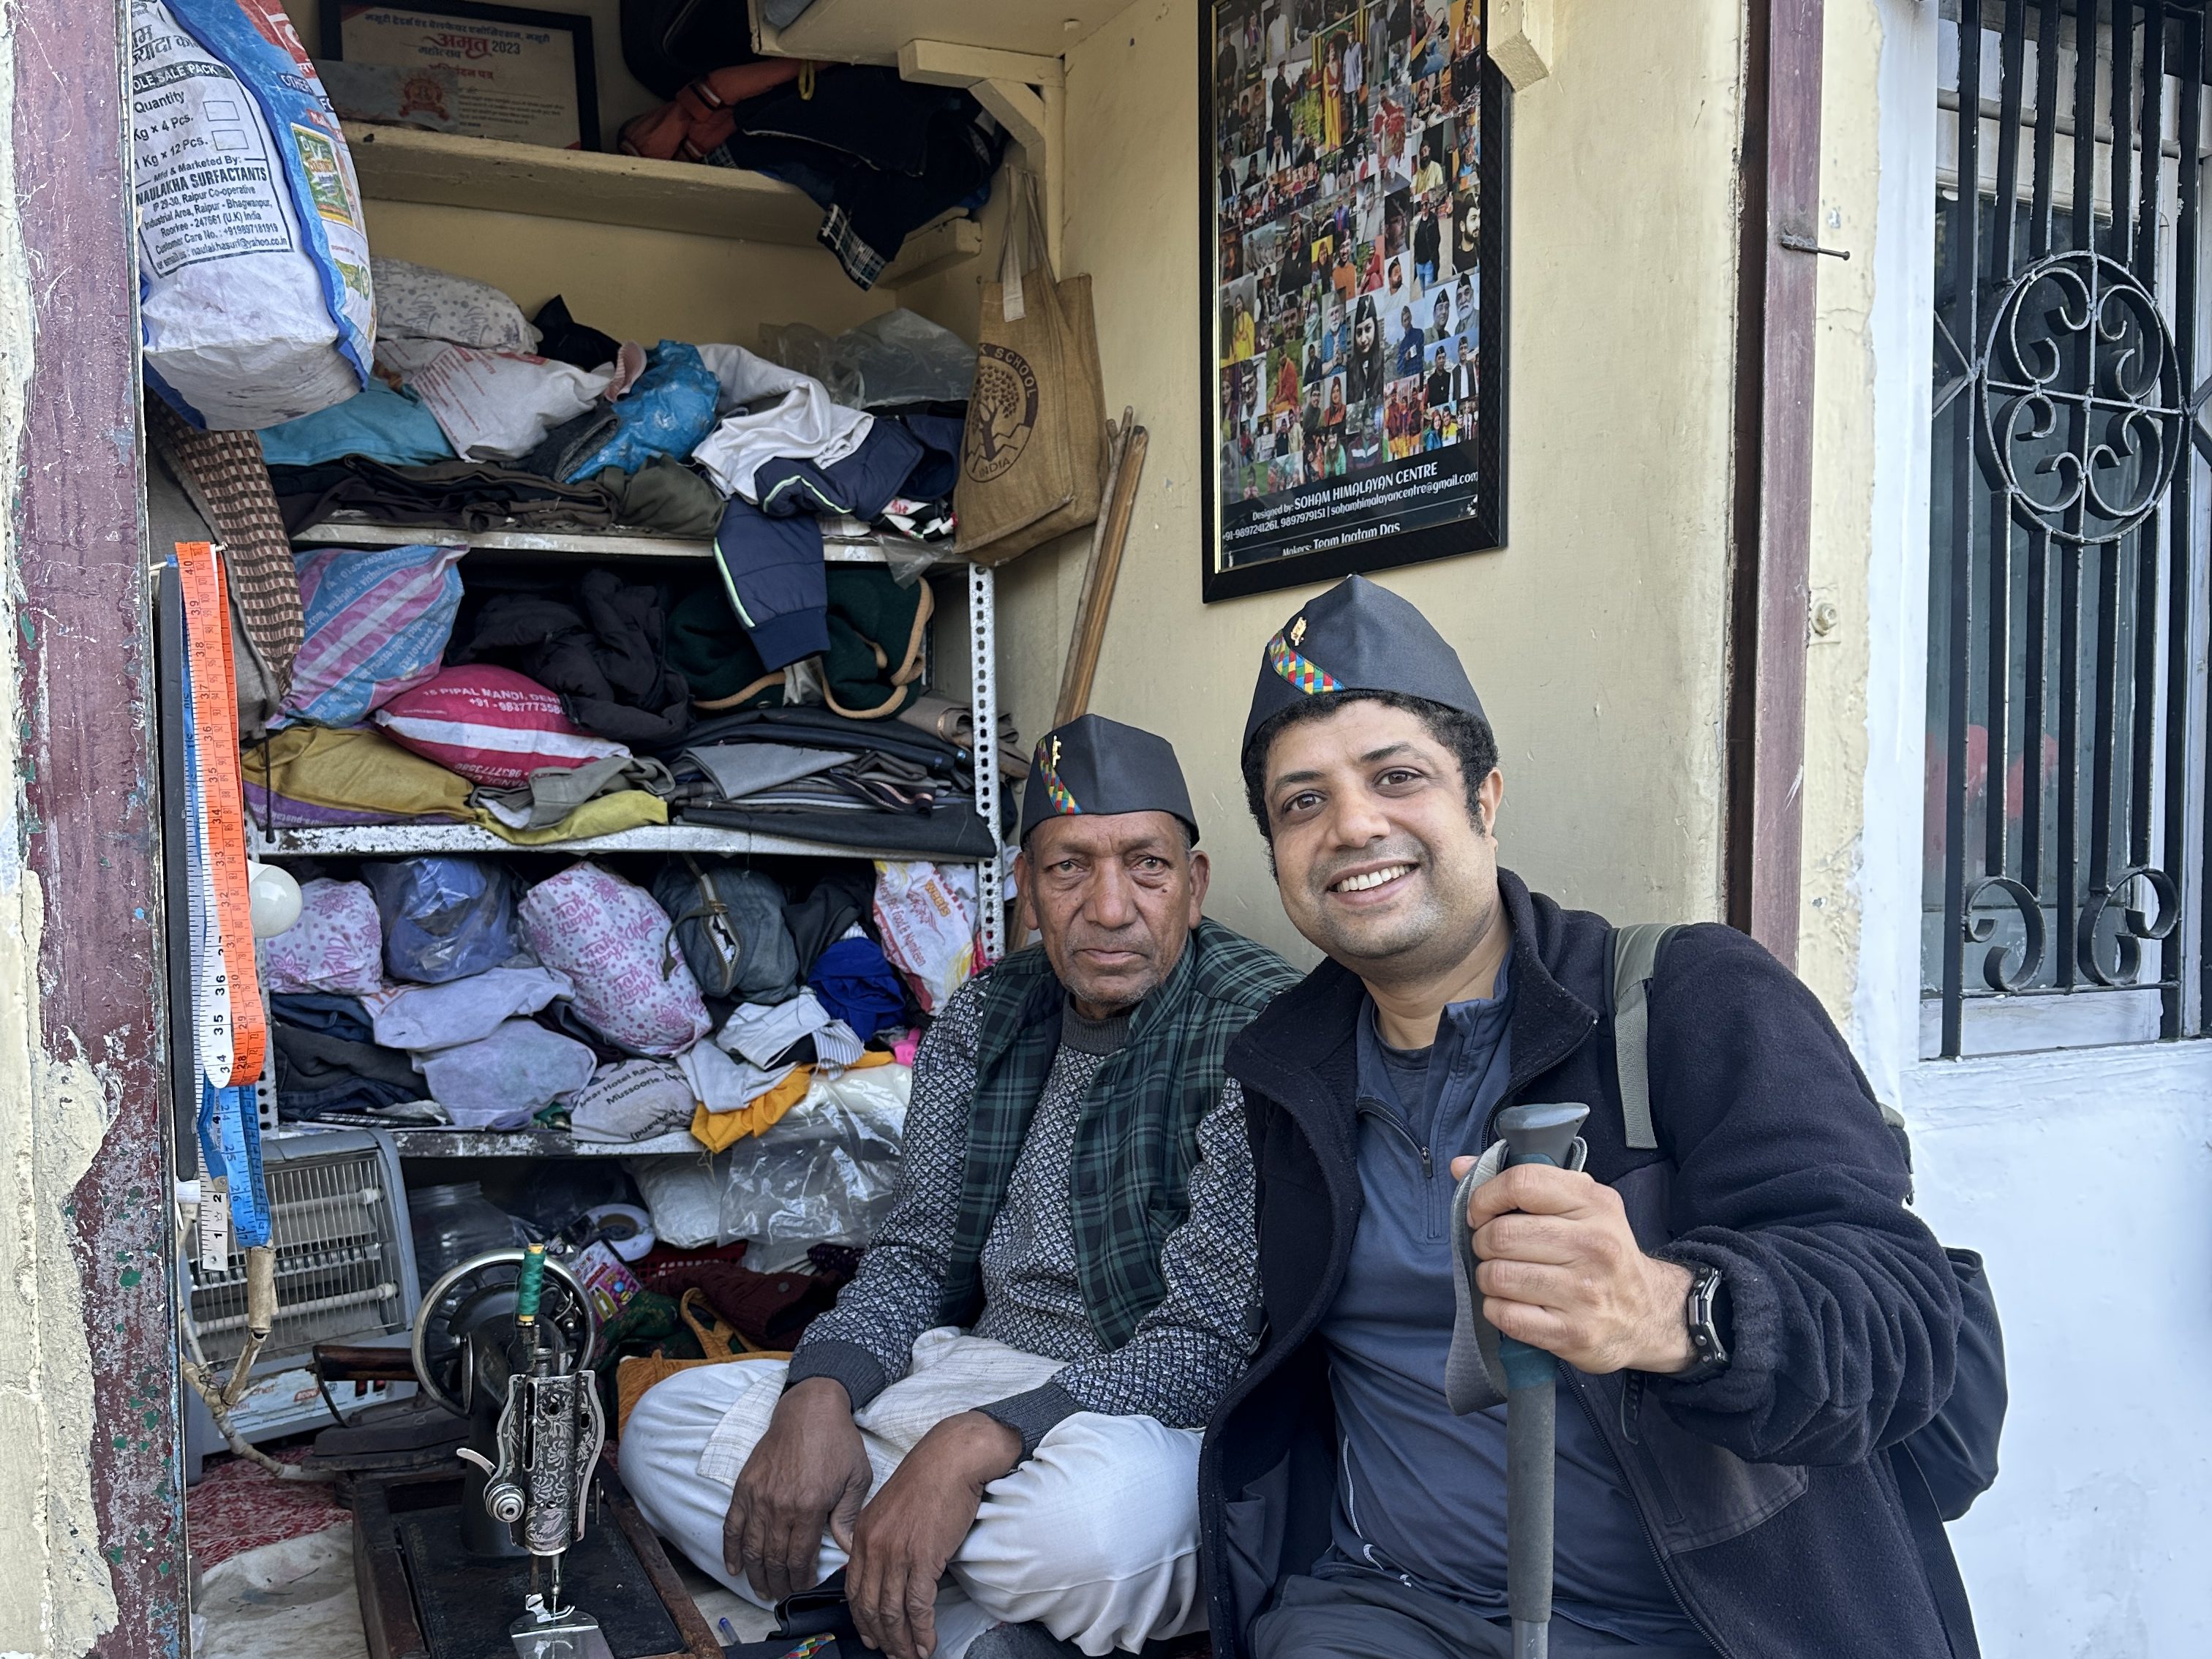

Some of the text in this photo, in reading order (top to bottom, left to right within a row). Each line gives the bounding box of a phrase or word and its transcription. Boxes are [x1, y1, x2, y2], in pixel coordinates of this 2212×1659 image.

[492, 40, 521, 55] 2023
[133, 63, 218, 91] OLE SALE PACK
[134, 91, 184, 113] Quantity
[162, 120, 169, 131] 4
[170, 114, 194, 129] Pcs.
[142, 154, 159, 167] Kg
[170, 143, 181, 156] 12
[183, 137, 208, 150] Pcs.
[178, 157, 222, 173] Marketed
[225, 156, 242, 166] By:
[135, 167, 268, 206] NAULAKHA SURFACTANTS
[183, 190, 208, 205] Raipur
[208, 185, 256, 198] Co-operative
[174, 207, 194, 218] Area,
[194, 203, 220, 215] Raipur
[160, 222, 189, 238] Roorkee
[244, 211, 262, 220] India
[184, 233, 203, 244] Care
[994, 347, 1037, 398] SCHOOL
[979, 457, 1011, 478] INDIA
[1252, 462, 1438, 521] Designed by: SOHAM HIMALAYAN CENTRE
[1331, 471, 1478, 516] sohamhimalayancentre@gmail.com
[1313, 535, 1339, 549] Team
[1380, 522, 1401, 536] Das
[183, 561, 193, 575] 40
[189, 601, 200, 615] 39
[195, 642, 205, 657] 38
[200, 684, 209, 699] 37
[440, 688, 481, 696] PIPAL
[469, 698, 489, 708] +91
[203, 726, 212, 741] 36
[208, 768, 217, 783] 35
[211, 809, 221, 824] 34
[214, 851, 225, 866] 33
[219, 892, 230, 907] 32
[226, 934, 235, 948] 31
[215, 975, 226, 996] 36
[231, 975, 240, 989] 30
[213, 1014, 224, 1035] 35
[238, 1016, 247, 1029] 29
[217, 1054, 230, 1074] 34
[236, 1056, 247, 1070] 28
[603, 1073, 632, 1092] Hotel
[606, 1077, 663, 1105] Mussoorie.
[213, 1194, 222, 1203] 2
[231, 1185, 242, 1201] 26
[236, 1225, 249, 1240] 27
